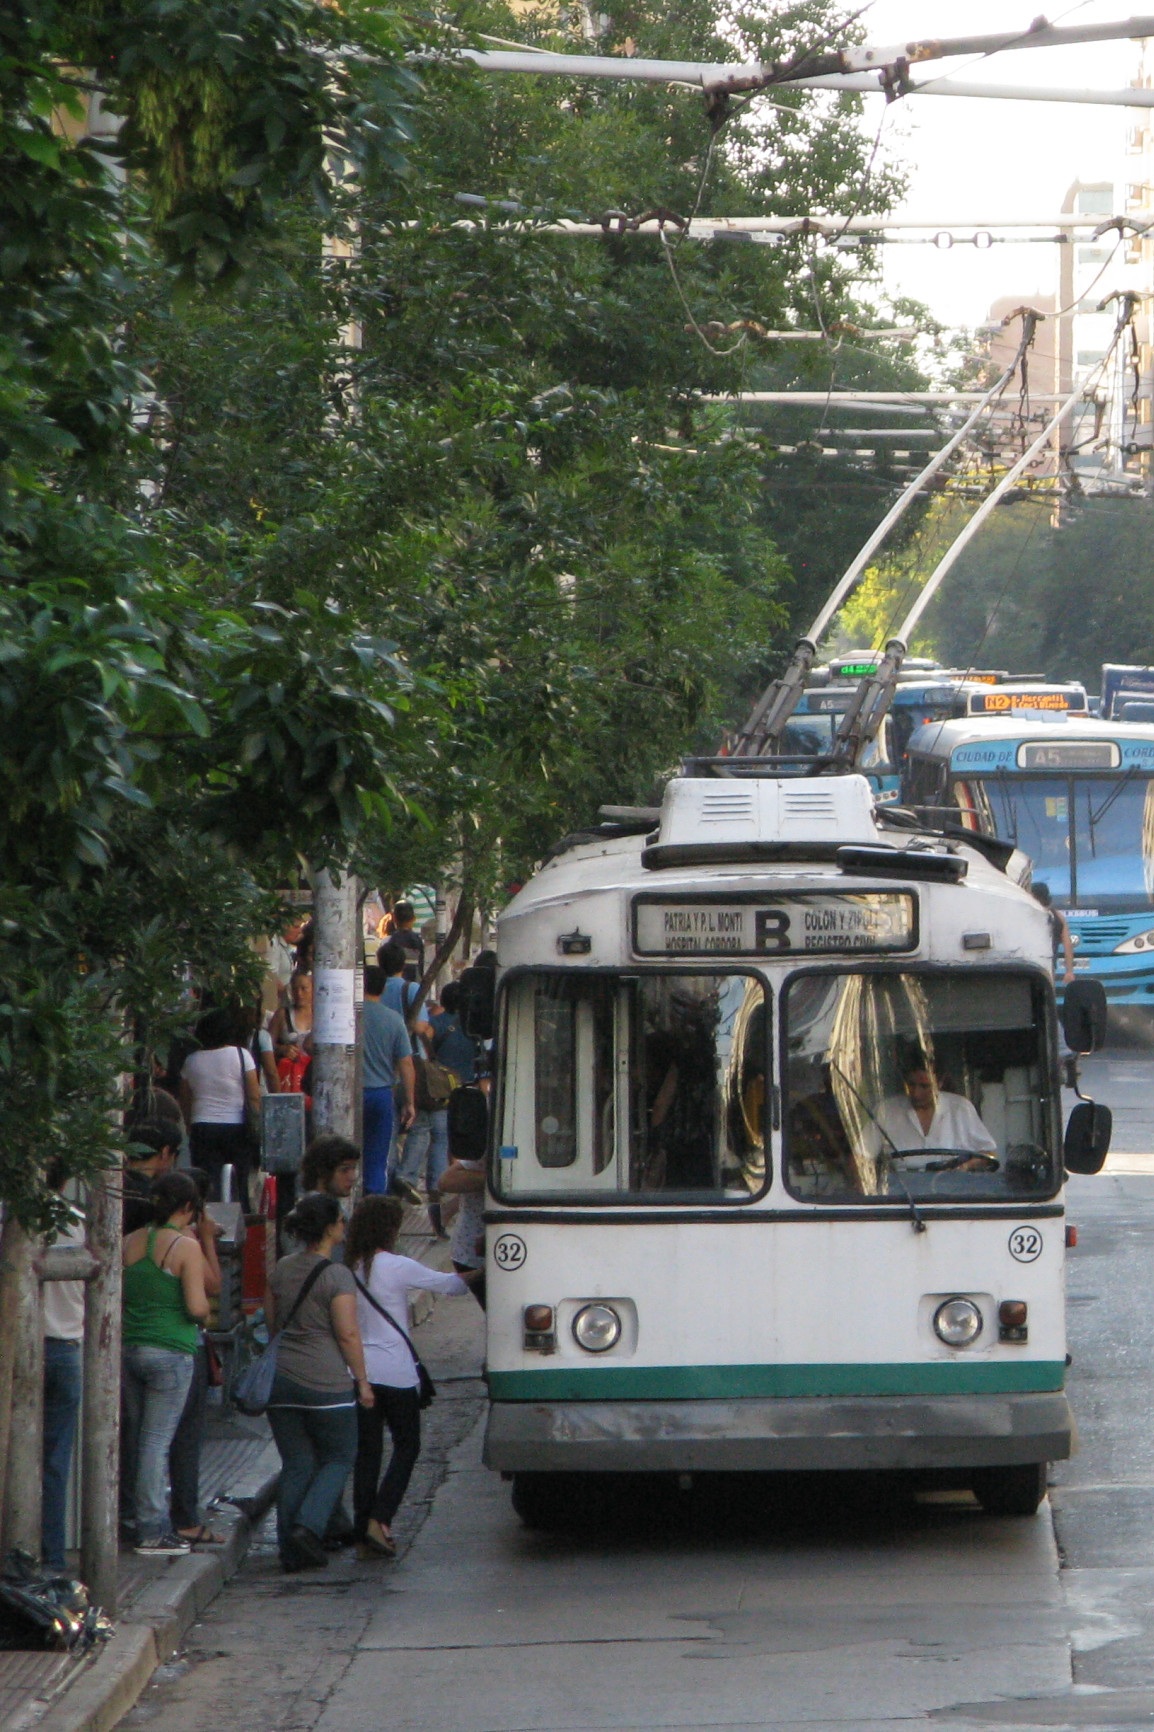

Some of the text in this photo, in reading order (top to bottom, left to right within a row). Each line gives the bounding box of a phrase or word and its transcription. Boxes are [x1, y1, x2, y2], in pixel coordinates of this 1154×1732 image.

[820, 700, 834, 709] A5
[987, 697, 1006, 707] N2
[956, 751, 994, 762] CIUDAD
[998, 751, 1012, 761] DE
[1035, 749, 1060, 764] A5
[665, 912, 691, 931] PATRIA
[718, 912, 742, 931] MONTI
[755, 910, 791, 949] B
[804, 911, 836, 930] COLON
[498, 1243, 521, 1262] 32
[1013, 1235, 1037, 1254] 32
